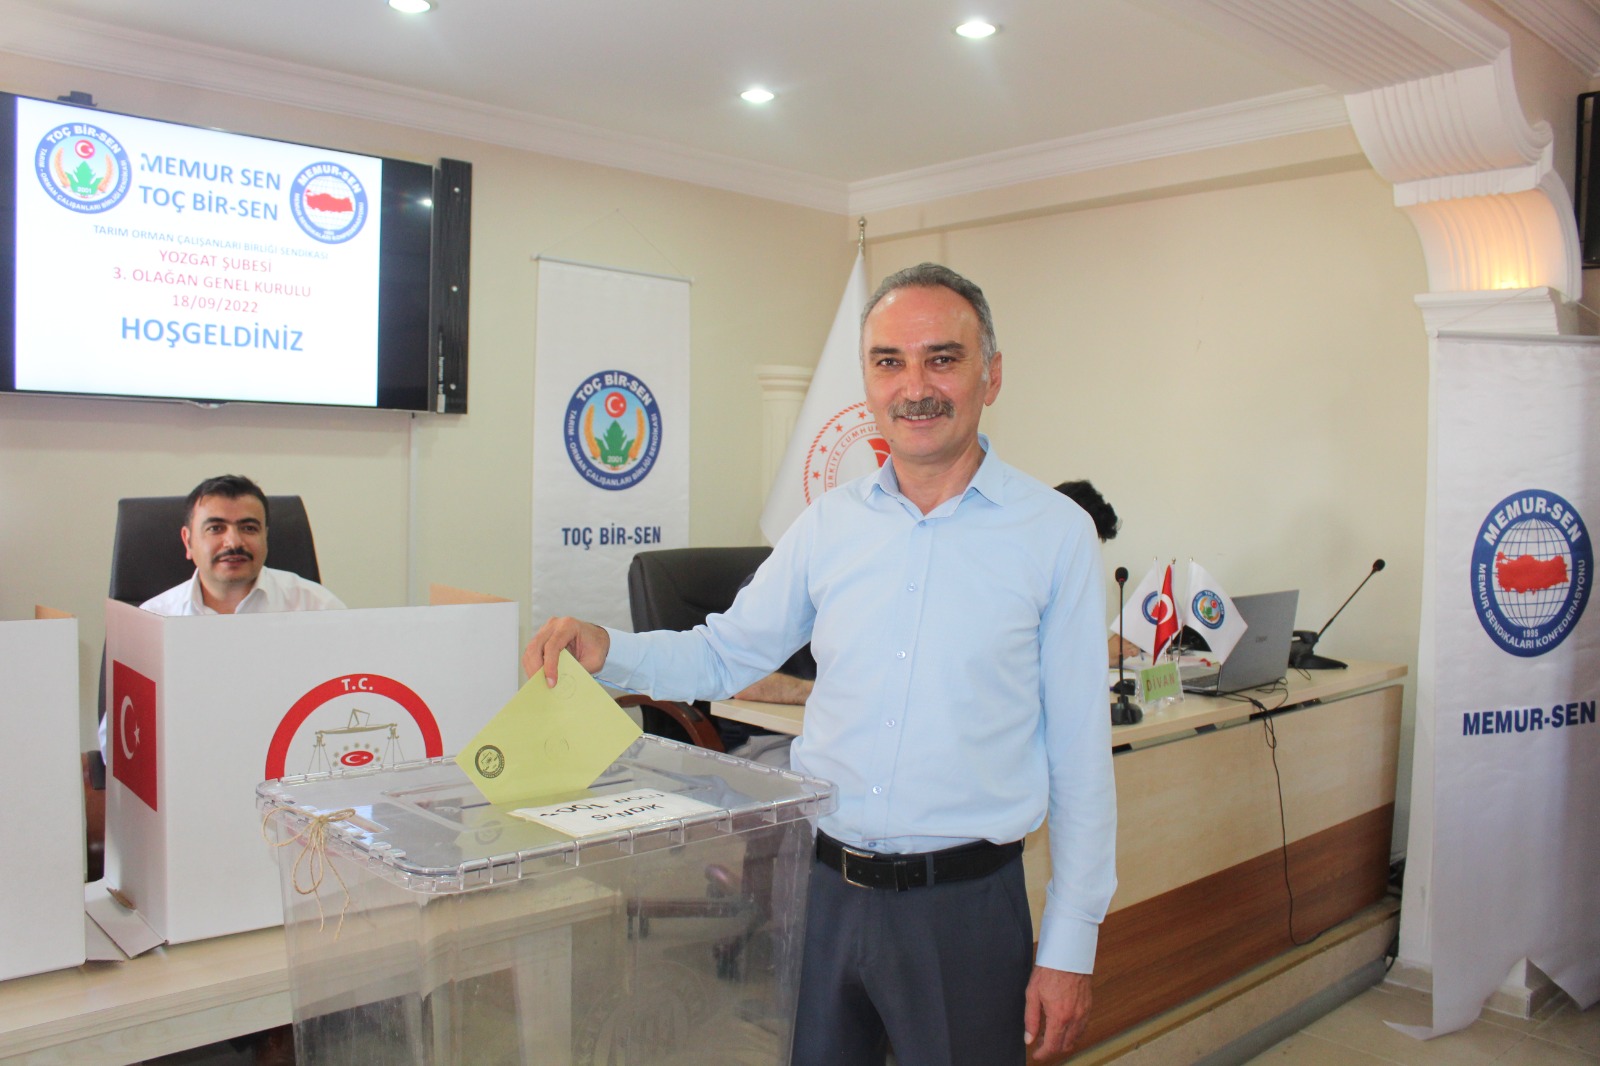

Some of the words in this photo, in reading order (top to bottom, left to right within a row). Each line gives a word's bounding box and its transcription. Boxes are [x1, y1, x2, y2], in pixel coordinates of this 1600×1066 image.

[46, 126, 71, 144] TOÇ
[73, 124, 122, 154] BİR-SEN
[140, 152, 233, 184] MEMUR
[240, 168, 280, 191] SEN
[297, 164, 362, 194] MEMUR-SEN
[138, 185, 186, 213] TOÇ
[193, 190, 278, 221] BİR-SEN
[93, 224, 129, 238] TARIM
[132, 230, 174, 243] ORMAN
[177, 234, 242, 251] ÇALIŞANLARI
[244, 241, 278, 254] BİRLİĞİ
[159, 249, 218, 268] YOZGAT
[222, 256, 273, 273] ŞUBESİ
[113, 266, 127, 281] 3.
[132, 268, 198, 287] OLAĞAN
[203, 275, 250, 292] GENEL
[254, 281, 312, 298] KURULU
[172, 294, 259, 313] 18/09/2022
[122, 316, 303, 352] HOŞGELDİNİZ
[576, 377, 602, 402] TOÇ
[604, 371, 653, 406] BİR-SEN
[568, 409, 577, 436] TARIM
[569, 442, 588, 472] ORMAN
[585, 468, 633, 486] ÇALIŞANLARI
[561, 526, 593, 551] TOÇ
[599, 522, 662, 545] BİR-SEN
[1482, 496, 1583, 547] MEMUR-SEN
[1478, 563, 1490, 610] MEMUR
[1485, 608, 1535, 649] SENDİKALARI
[1536, 559, 1586, 649] KONFEDERASYONU
[1522, 629, 1539, 639] 1995
[341, 677, 374, 691] T.C.
[1146, 672, 1175, 692] DİVAN
[1462, 700, 1597, 737] MEMUR-SEN
